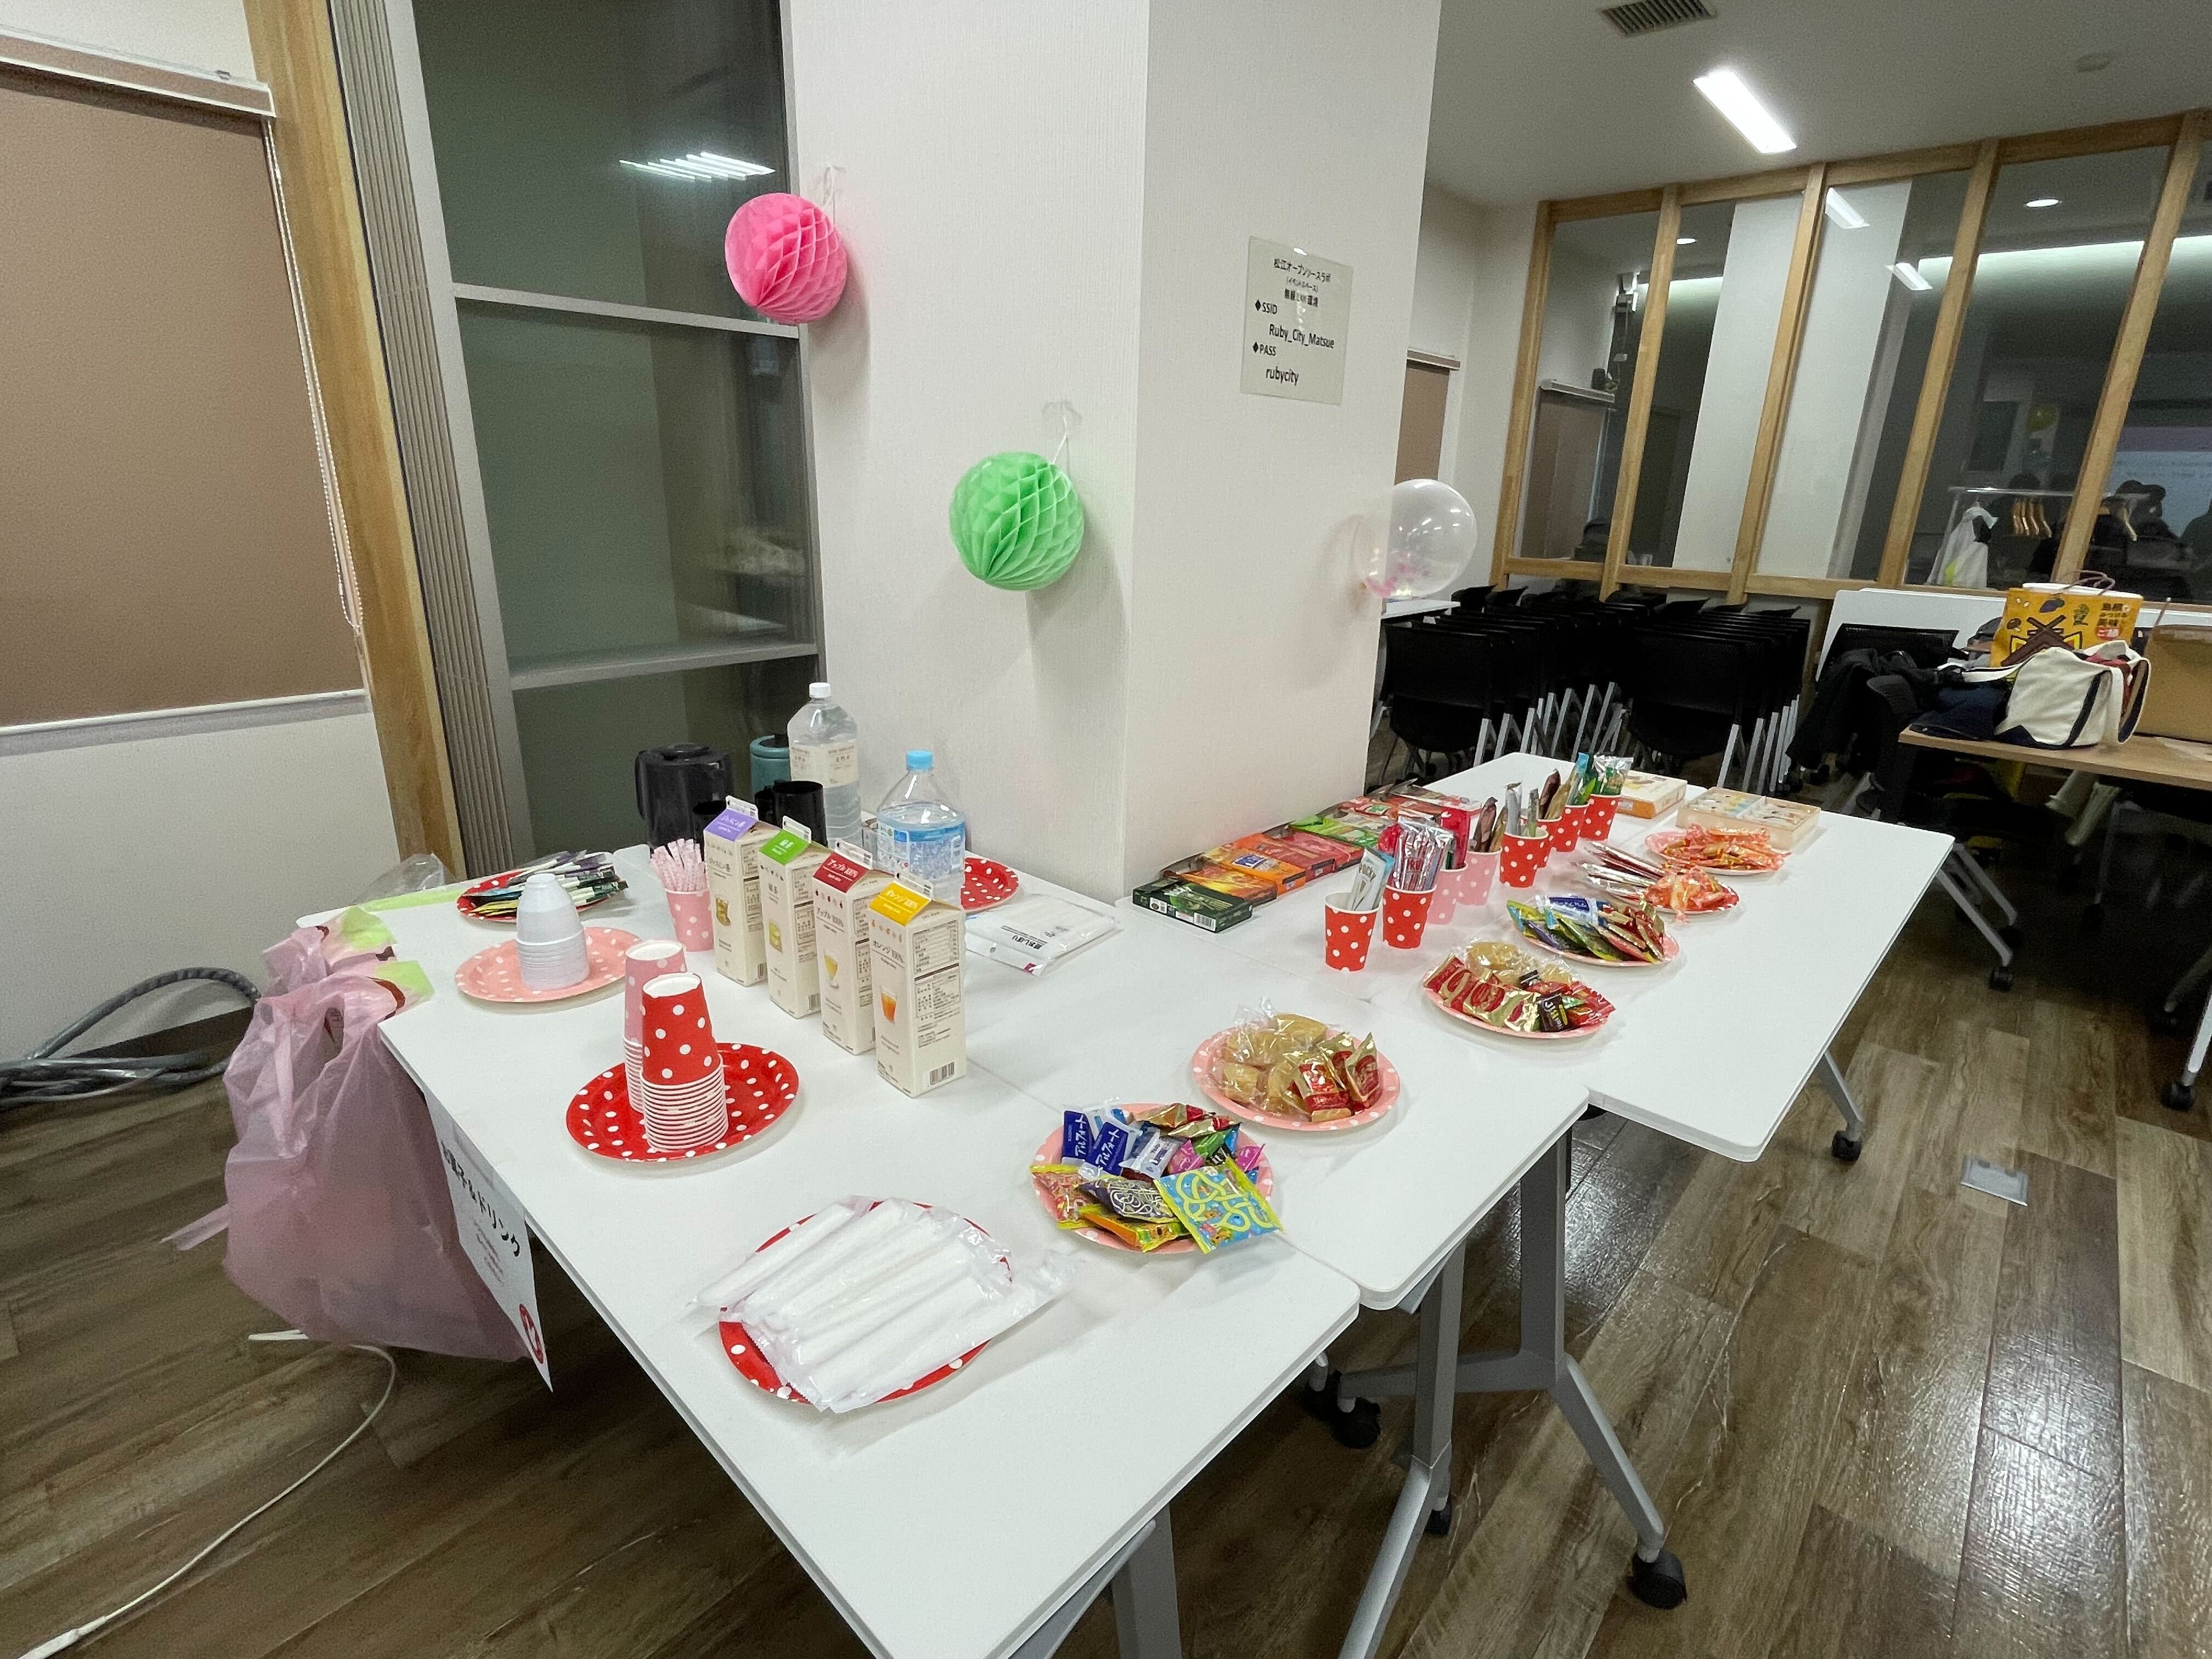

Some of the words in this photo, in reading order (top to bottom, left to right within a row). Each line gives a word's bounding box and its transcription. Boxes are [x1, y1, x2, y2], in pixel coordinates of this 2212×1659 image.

[1262, 302, 1278, 314] SSID
[1269, 324, 1334, 349] Ruby_City_Matsue
[1260, 344, 1277, 356] PASS
[1266, 365, 1299, 386] rubycity
[1074, 1114, 1087, 1155] アルフォート
[1096, 1129, 1120, 1166] アルフォート
